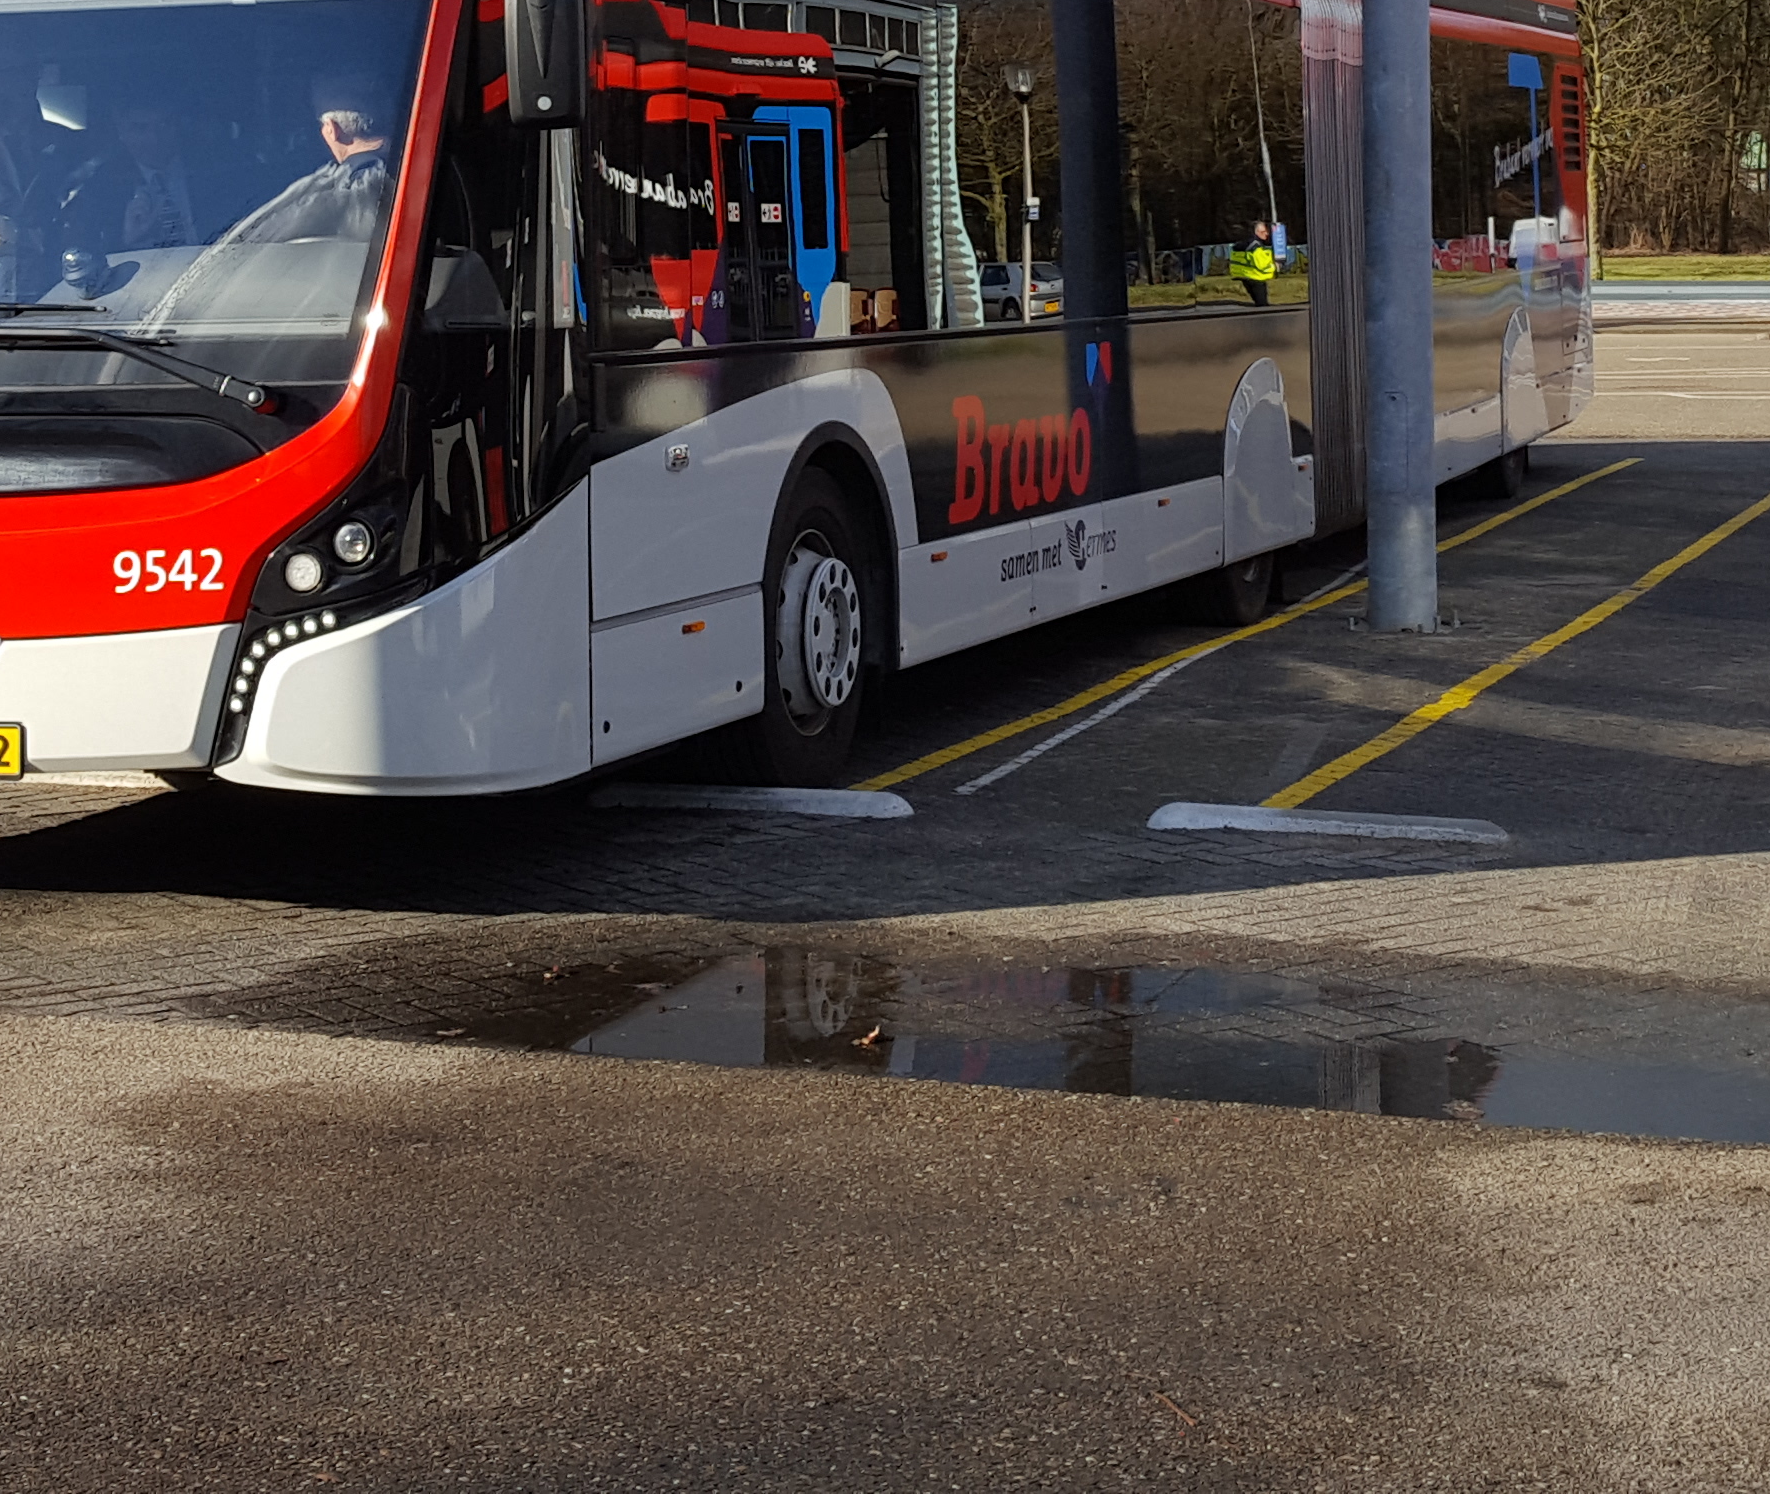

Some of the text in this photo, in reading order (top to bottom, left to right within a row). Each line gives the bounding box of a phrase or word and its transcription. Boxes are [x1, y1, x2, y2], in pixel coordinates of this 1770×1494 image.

[948, 395, 1092, 525] Bravo
[112, 547, 225, 594] 9542
[1000, 550, 1039, 582] samen
[1041, 538, 1063, 570] met
